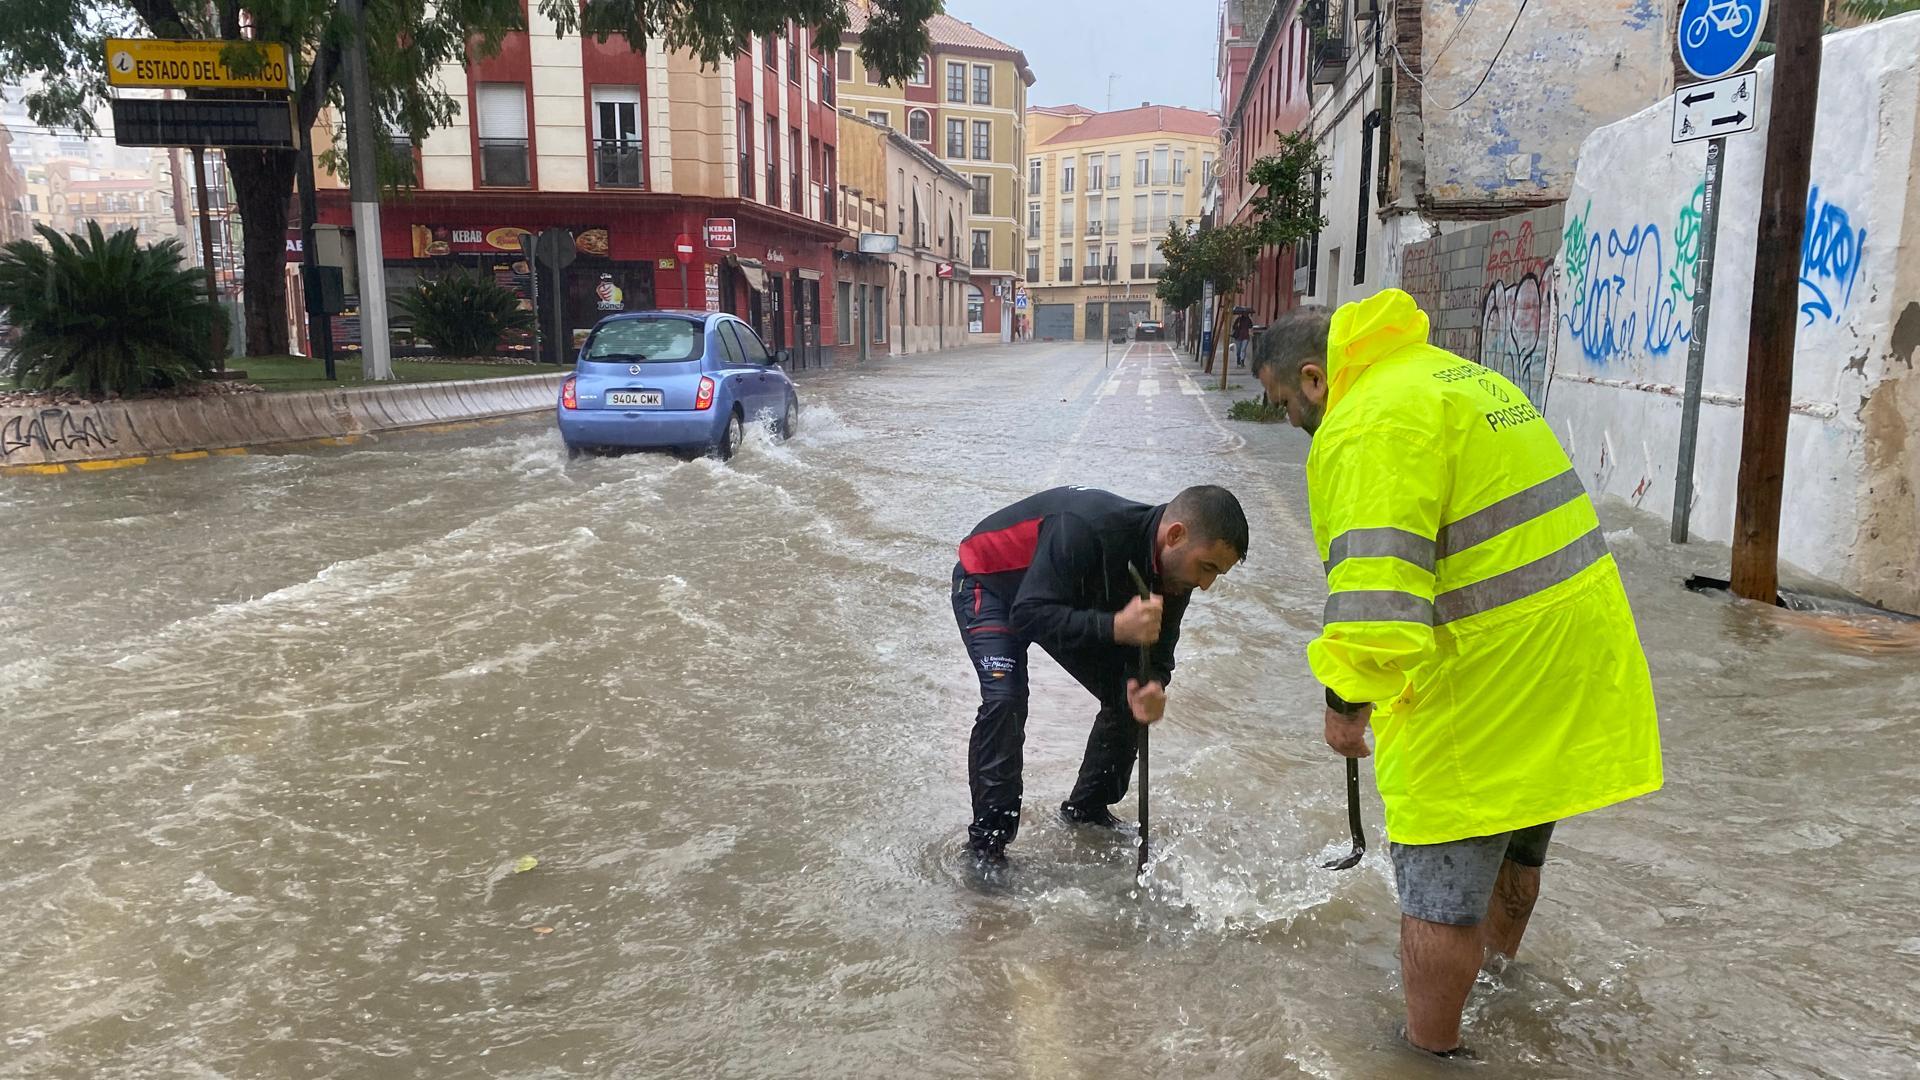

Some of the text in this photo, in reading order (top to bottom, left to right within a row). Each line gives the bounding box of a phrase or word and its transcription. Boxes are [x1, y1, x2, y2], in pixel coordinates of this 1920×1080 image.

[136, 60, 190, 80] ESTADO
[193, 62, 220, 81] DEL
[452, 230, 482, 243] KEBAB
[613, 394, 659, 404] 9404 CMK
